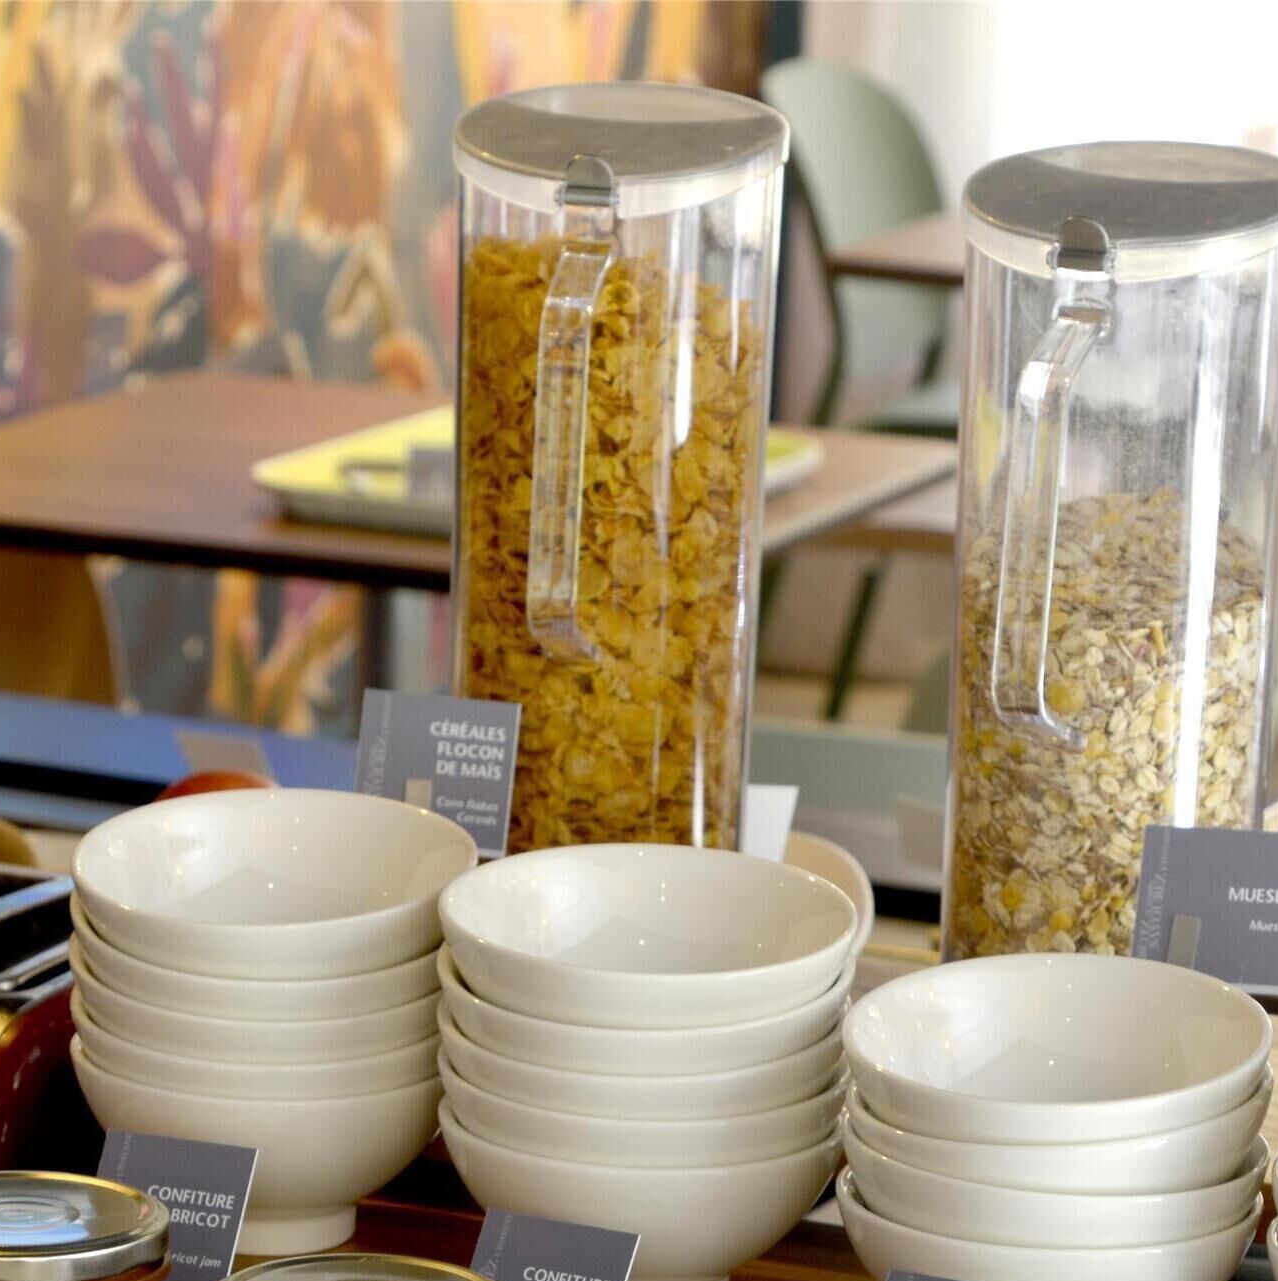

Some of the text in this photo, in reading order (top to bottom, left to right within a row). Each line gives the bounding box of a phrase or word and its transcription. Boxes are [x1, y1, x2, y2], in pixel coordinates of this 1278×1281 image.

[430, 719, 506, 742] CÉRÉALES
[437, 741, 504, 760] FLOCON
[436, 760, 502, 780] DE MAÏS
[148, 1185, 235, 1210] CONFITURE
[171, 1208, 231, 1228] BRICOT
[171, 1252, 221, 1268] ricot jam
